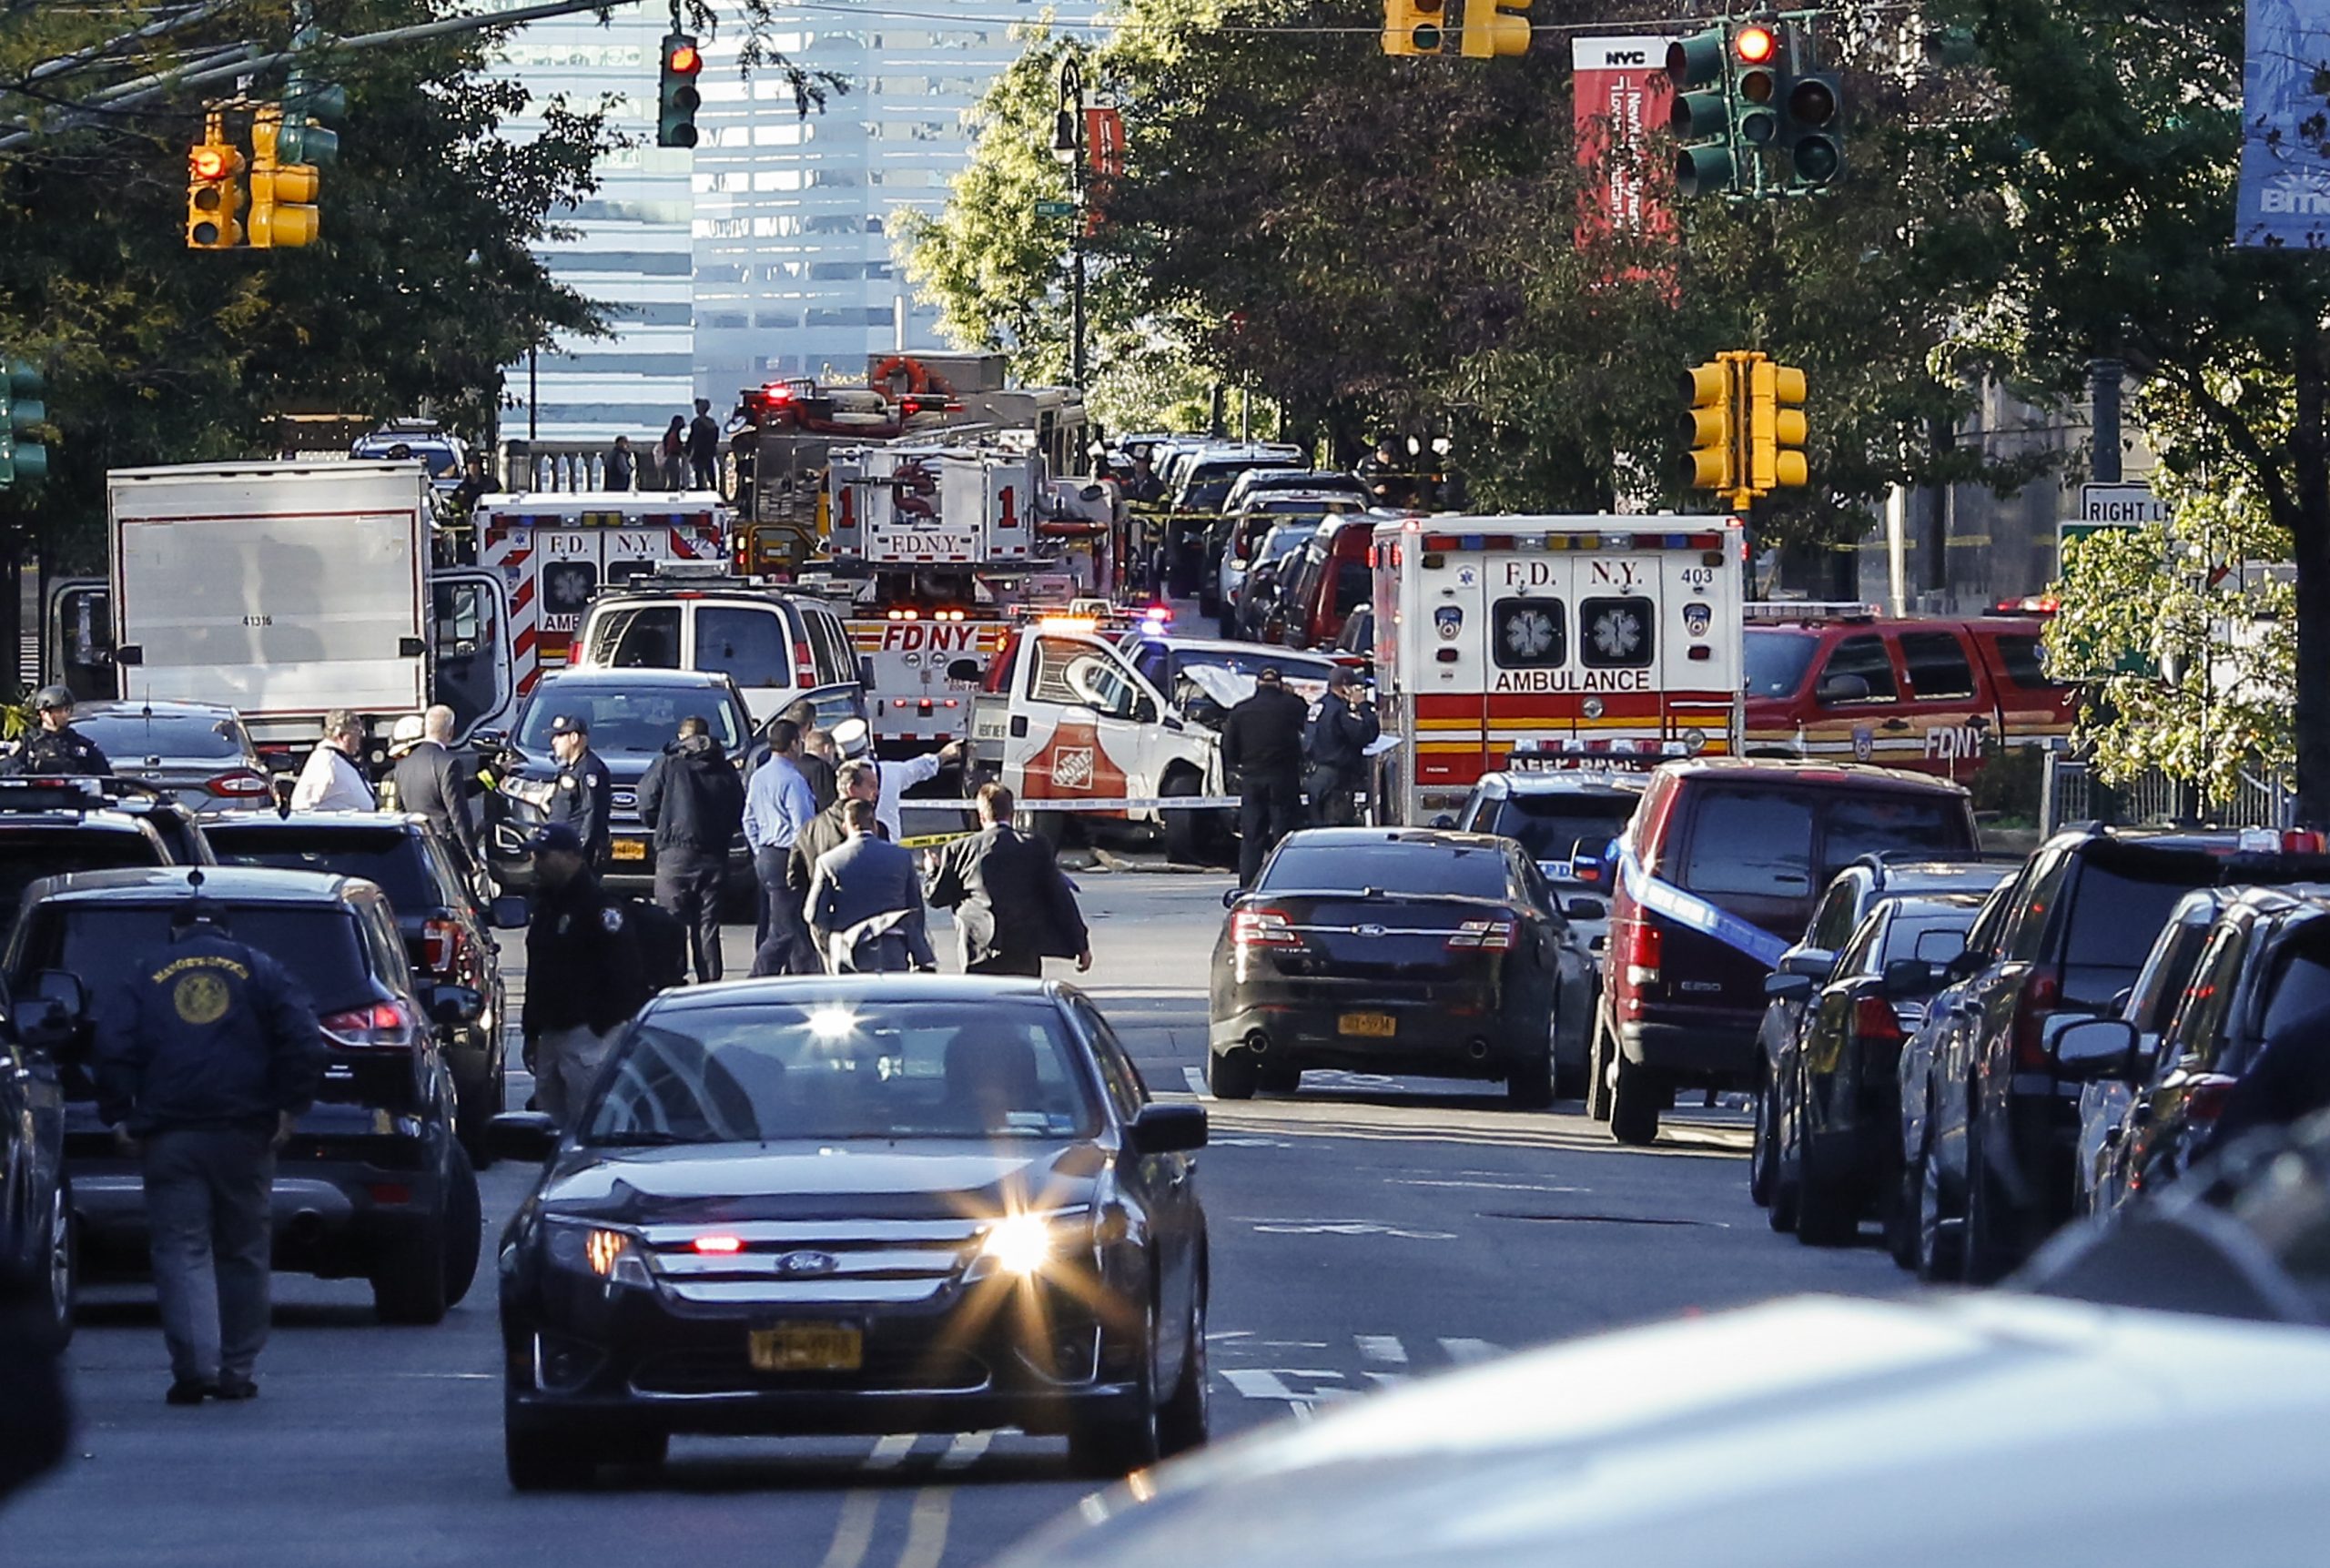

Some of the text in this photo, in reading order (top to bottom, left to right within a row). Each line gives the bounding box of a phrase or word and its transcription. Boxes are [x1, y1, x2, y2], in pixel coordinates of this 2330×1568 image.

[1606, 51, 1646, 65] NYC
[838, 487, 856, 528] 1
[998, 486, 1018, 528] 1
[2090, 502, 2144, 521] RIGHT
[550, 534, 654, 553] F.D. N.Y.
[892, 535, 959, 552] F.D.N.Y.
[1505, 561, 1642, 585] F.D. N.Y.
[1681, 569, 1713, 583] 403
[242, 615, 272, 626] 41316
[882, 625, 978, 651] FDNY
[1495, 670, 1650, 691] AMBULANCE
[1925, 726, 1988, 759] FDNY
